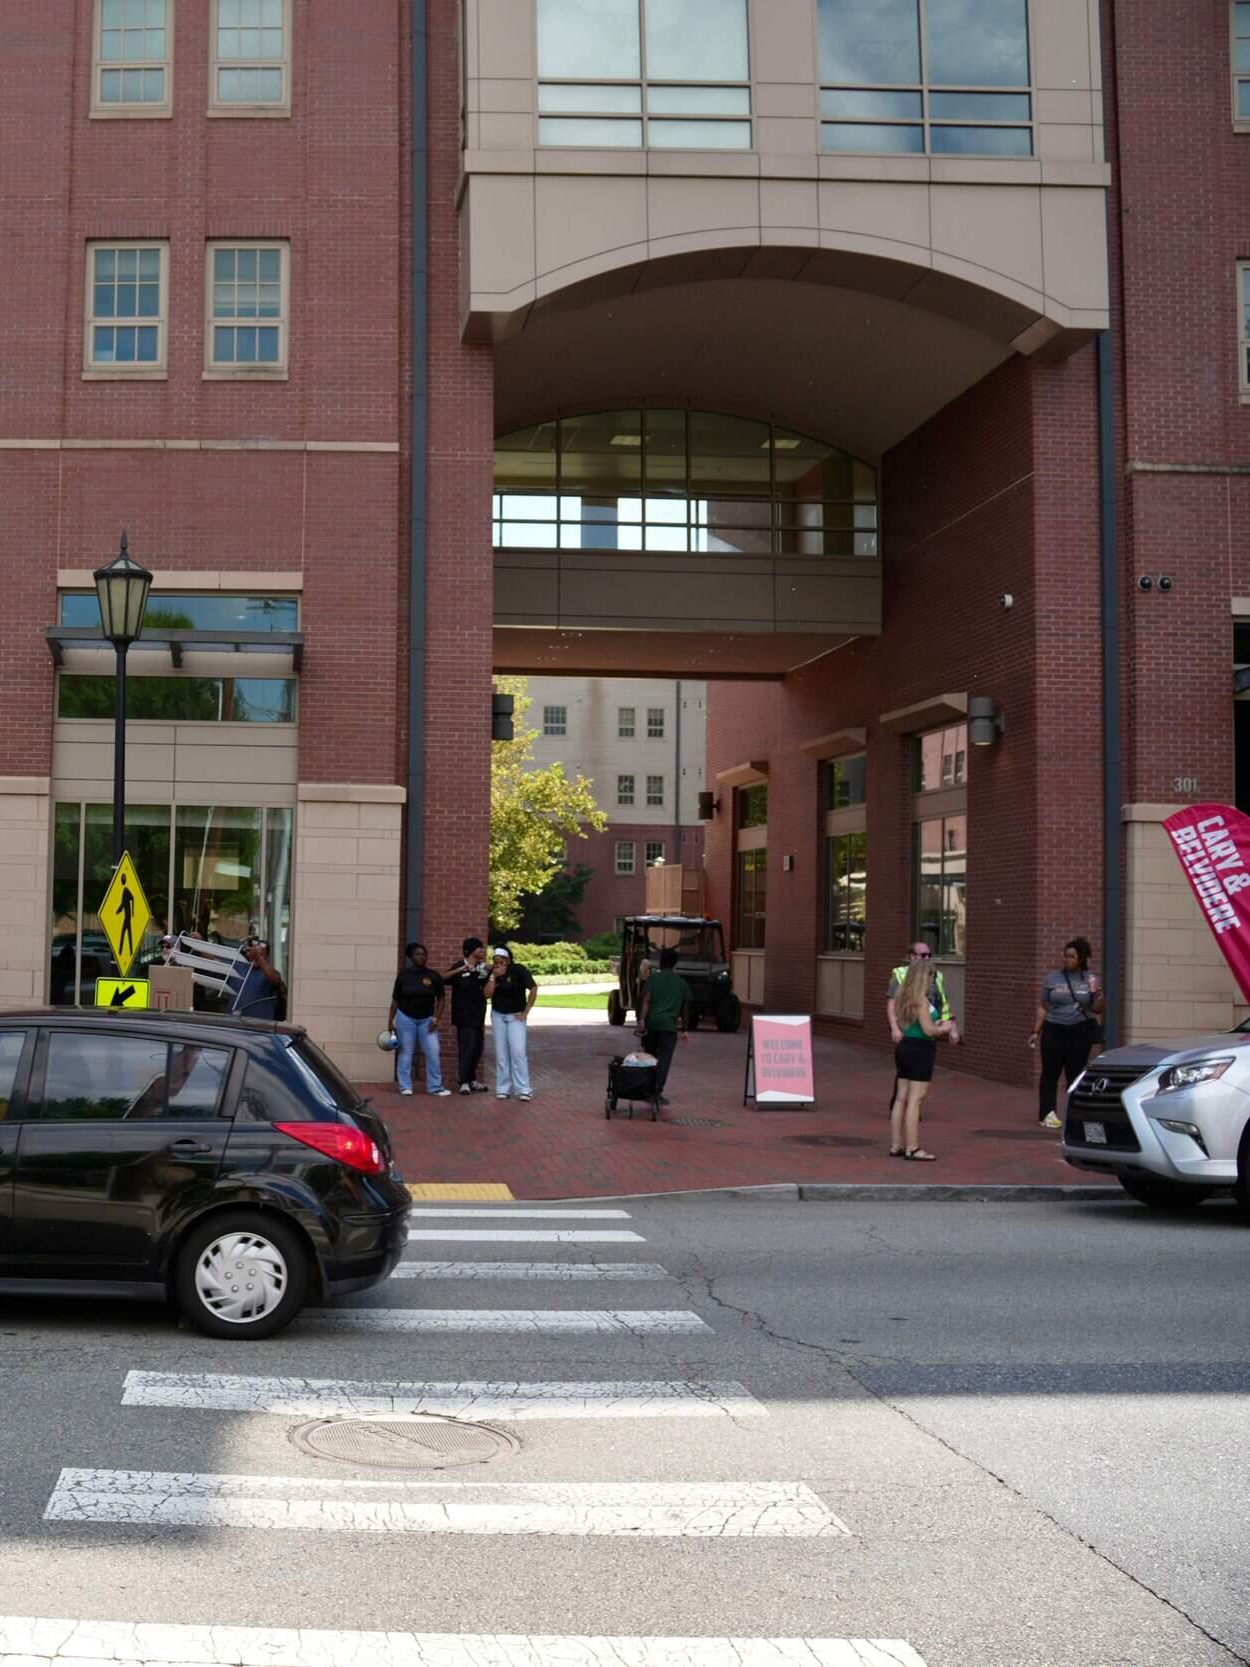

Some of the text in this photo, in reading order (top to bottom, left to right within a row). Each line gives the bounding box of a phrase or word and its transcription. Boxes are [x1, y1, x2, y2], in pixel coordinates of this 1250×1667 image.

[1173, 776, 1199, 793] 301
[1171, 824, 1241, 934] BELVIDERE
[1197, 815, 1250, 895] CARY &
